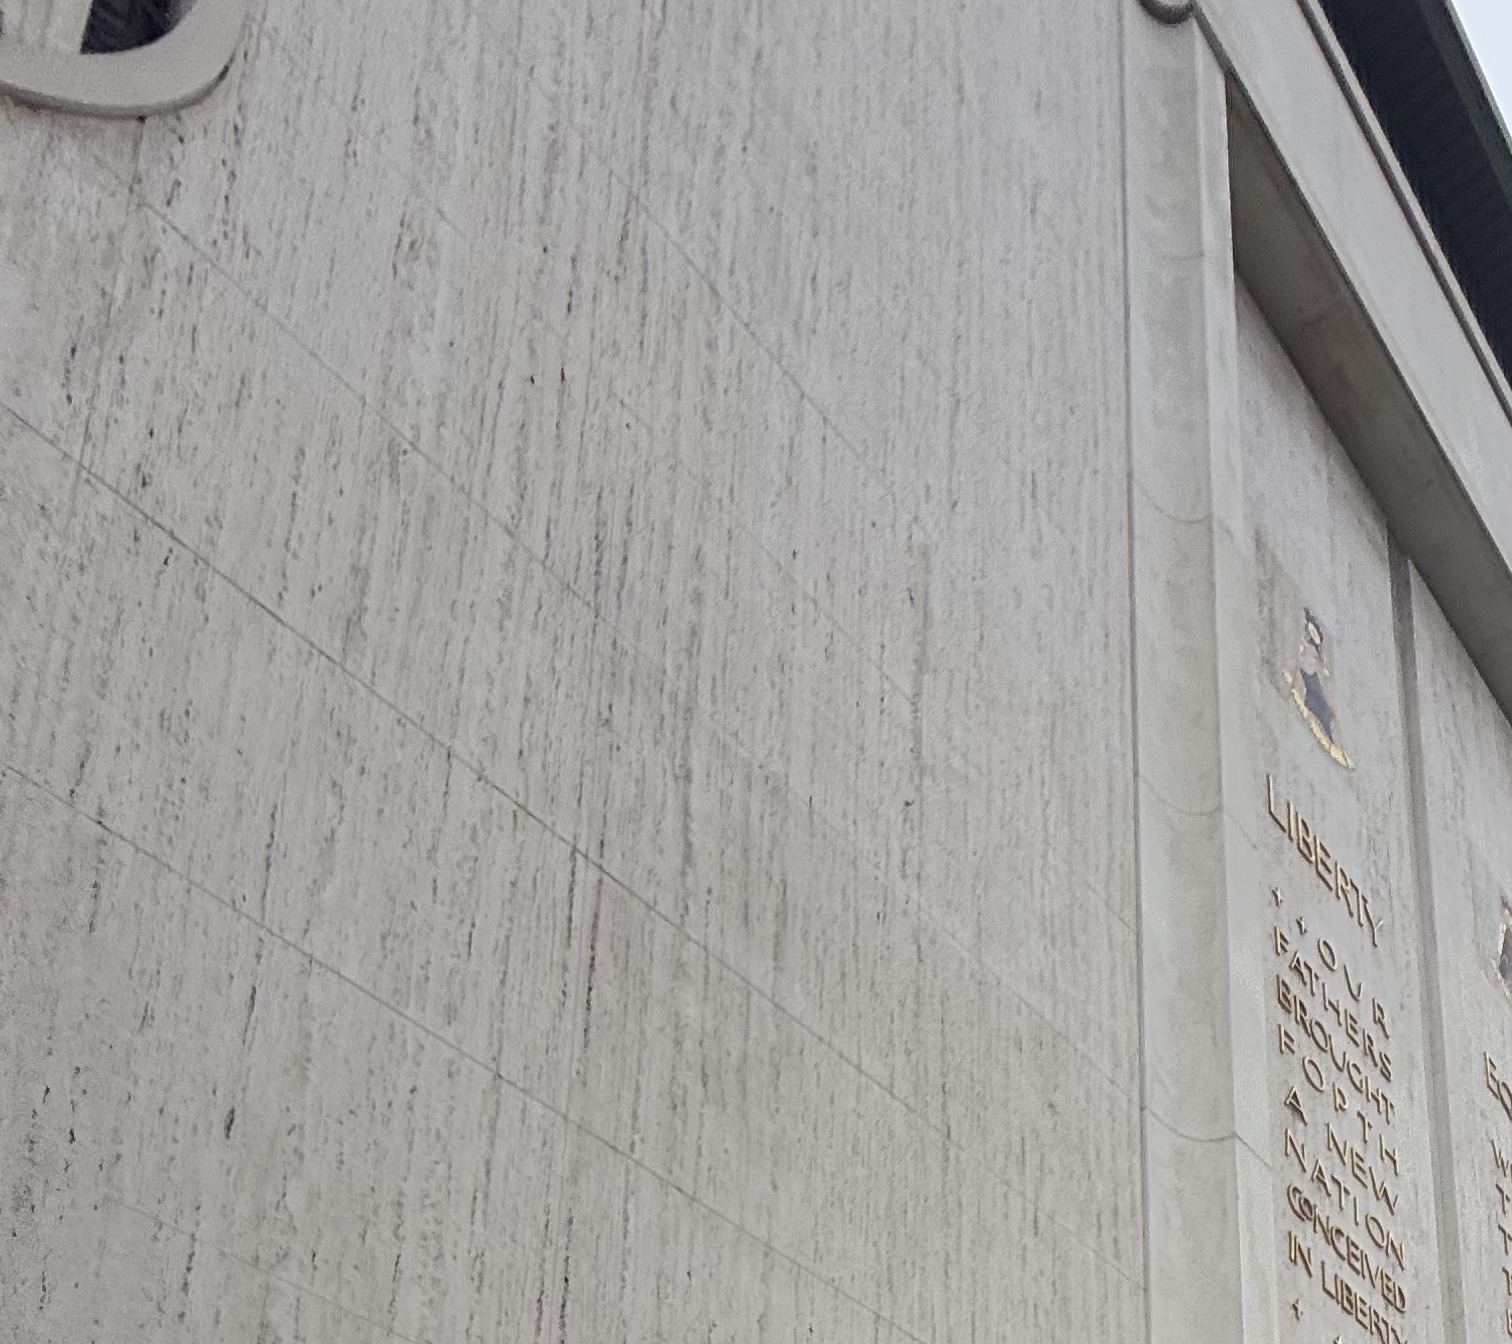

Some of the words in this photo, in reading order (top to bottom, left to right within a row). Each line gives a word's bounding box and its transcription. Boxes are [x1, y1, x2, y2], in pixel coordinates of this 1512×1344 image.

[1266, 774, 1384, 947] LIBERTY
[1274, 926, 1392, 1082] FATHERS
[1276, 974, 1394, 1125] BROUGHT
[1317, 937, 1389, 1040] OUR
[1277, 1023, 1398, 1176] FORTH
[1284, 1086, 1308, 1126] A
[1326, 1122, 1398, 1215] NEW
[1285, 1127, 1405, 1270] NATION
[1286, 1184, 1407, 1313] CONCEIVED
[1288, 1230, 1312, 1278] IN
